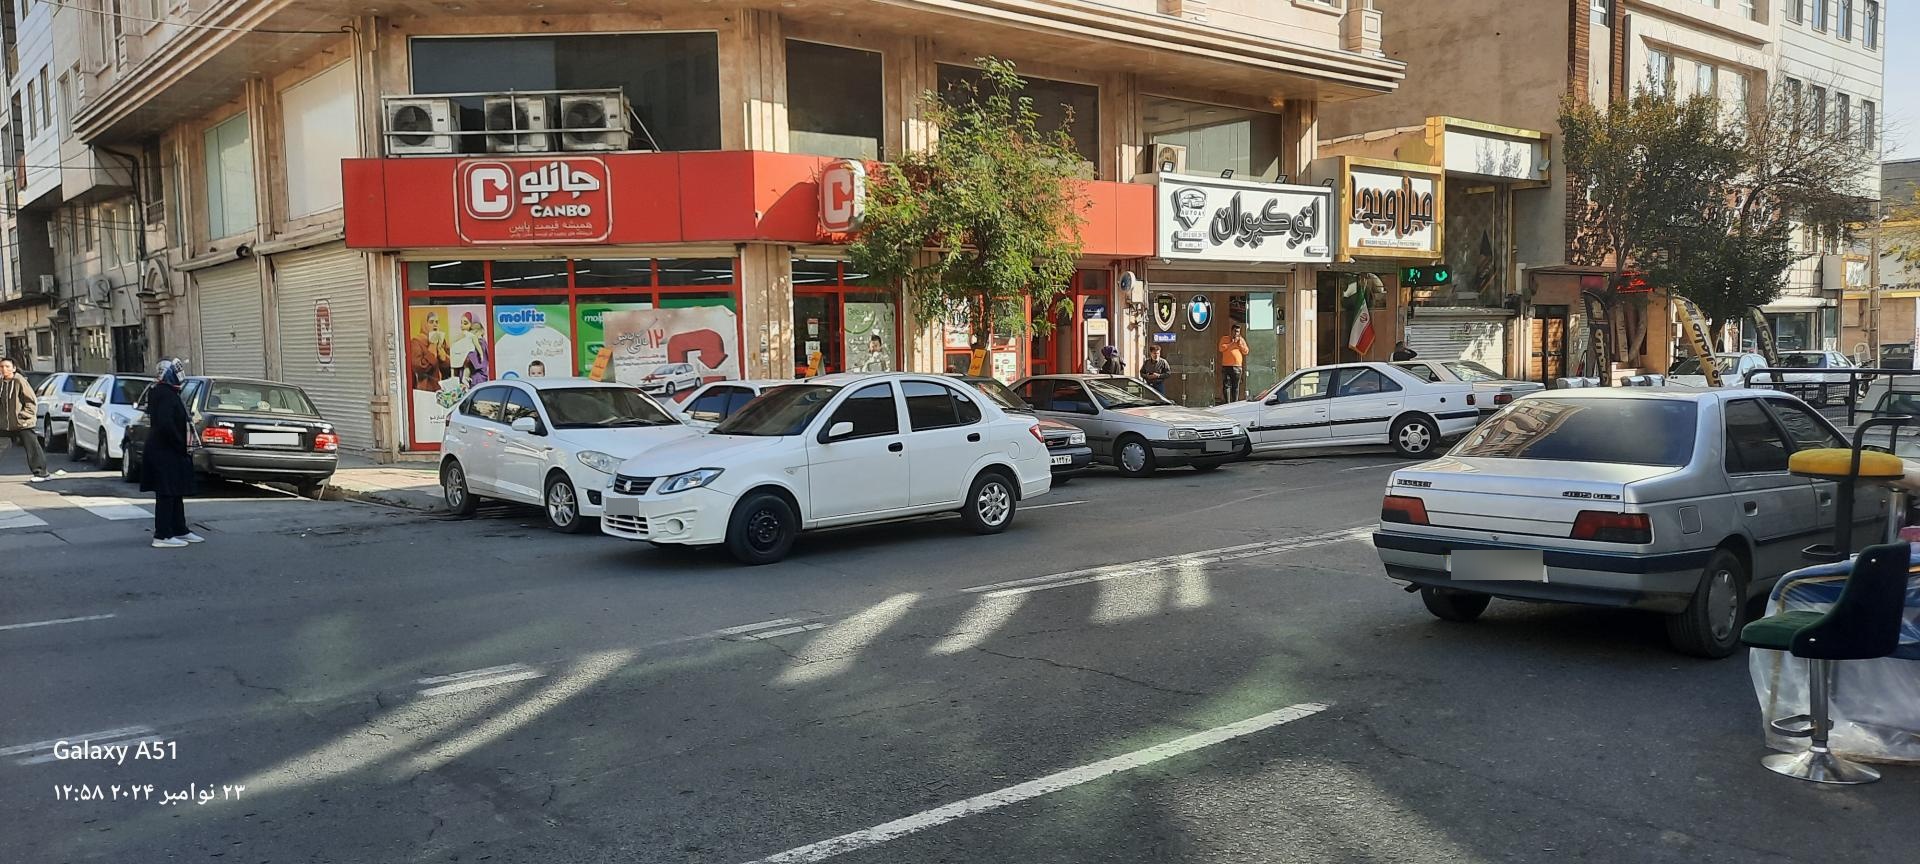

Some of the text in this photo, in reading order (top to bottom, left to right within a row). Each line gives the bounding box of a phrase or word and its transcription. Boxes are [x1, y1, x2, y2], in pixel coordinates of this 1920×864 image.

[520, 161, 600, 204] جانبو
[530, 204, 591, 217] CANBO
[534, 221, 559, 231] قیمت
[1209, 191, 1292, 248] کیوان
[499, 310, 545, 323] molfix
[647, 329, 664, 349] ۱۲
